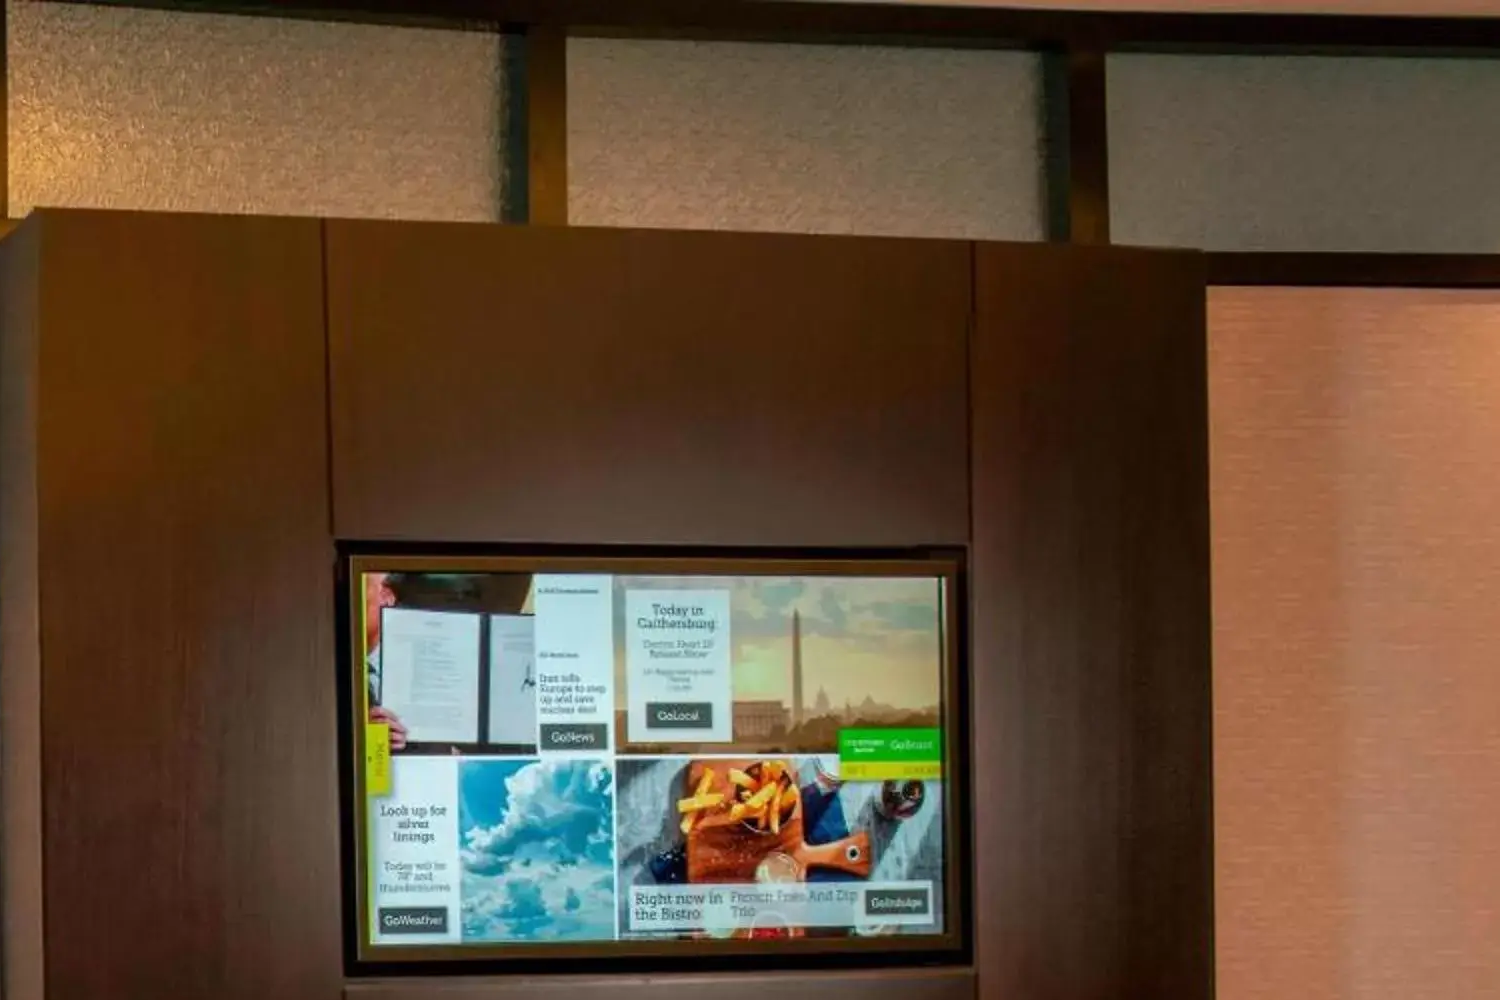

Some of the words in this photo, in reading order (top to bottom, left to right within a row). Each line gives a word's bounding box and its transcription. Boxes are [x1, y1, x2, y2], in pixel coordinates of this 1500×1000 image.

[651, 603, 688, 619] Today
[691, 606, 704, 616] in
[657, 709, 700, 722] GoLocal
[551, 731, 595, 744] GoNews
[380, 804, 409, 817] Look
[411, 806, 428, 818] up
[429, 804, 447, 816] for
[398, 818, 429, 829] silver
[393, 831, 436, 845] linings
[635, 893, 672, 909] Right
[674, 895, 705, 906] now
[708, 891, 723, 905] in
[809, 889, 834, 903] And
[384, 914, 444, 927] GoWeather
[635, 908, 658, 921] the
